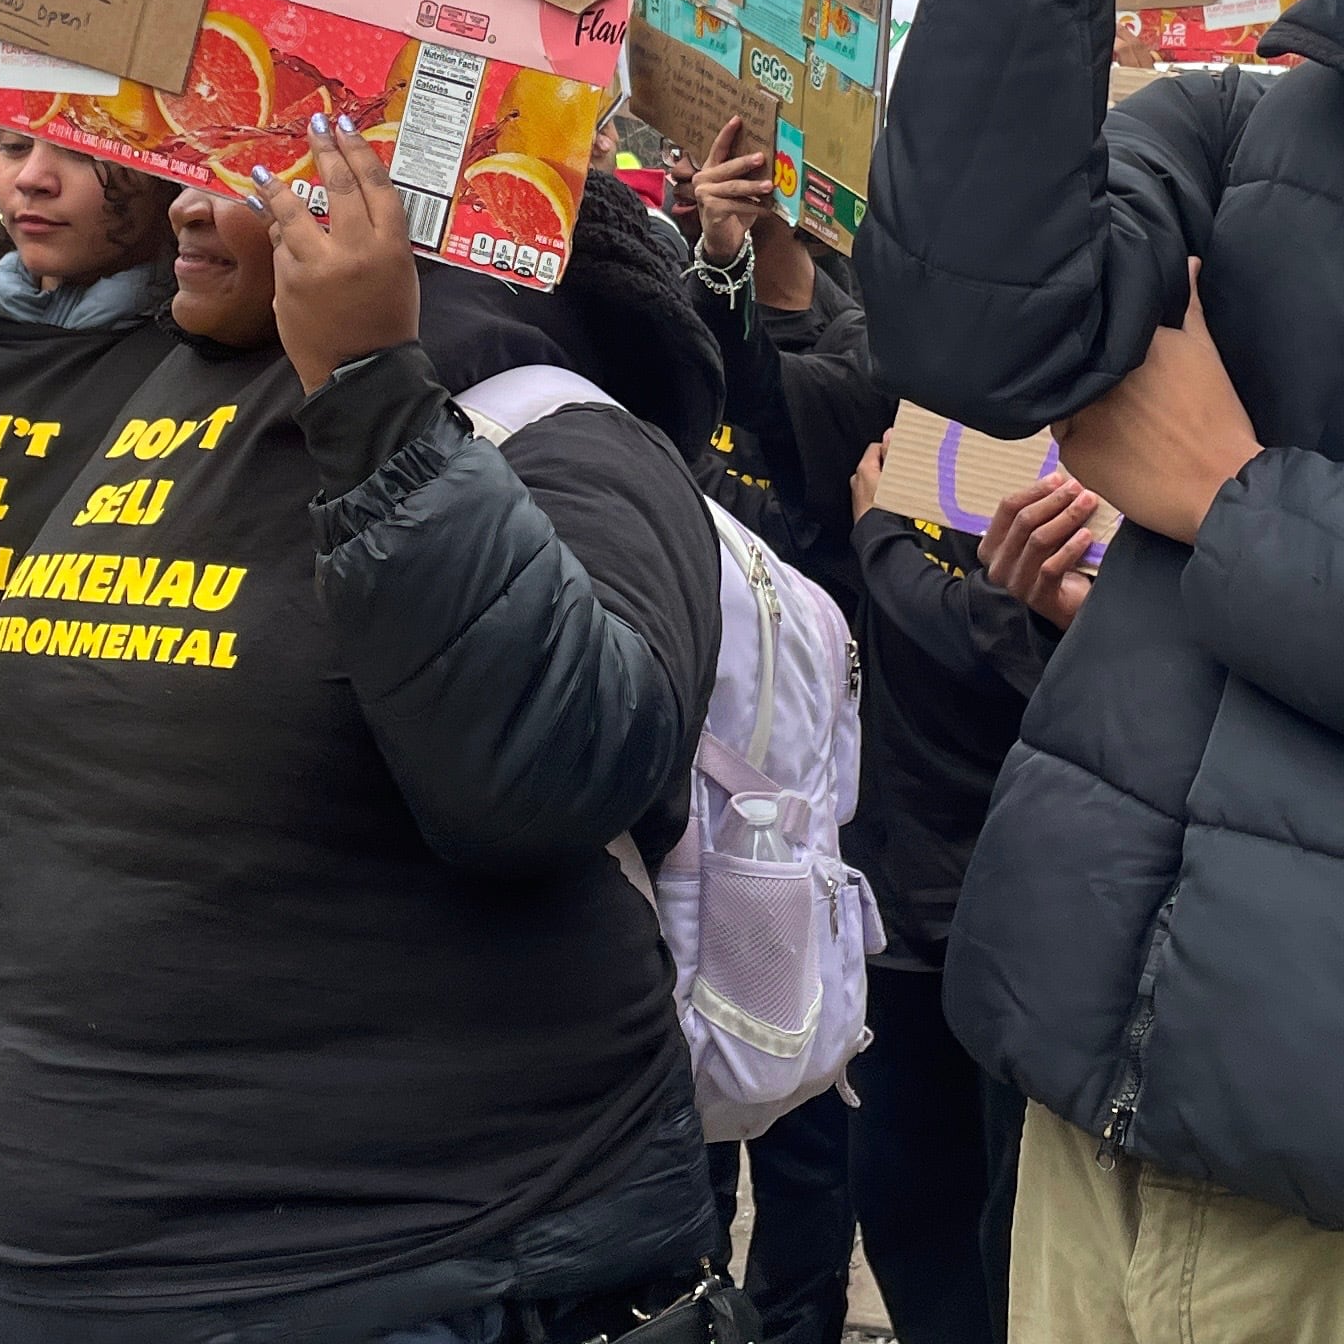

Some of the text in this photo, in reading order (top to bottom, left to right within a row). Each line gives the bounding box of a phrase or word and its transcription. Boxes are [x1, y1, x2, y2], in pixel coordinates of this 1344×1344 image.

[1162, 22, 1187, 36] 12
[1162, 35, 1187, 47] PACK
[415, 77, 474, 102] Calories 0
[72, 478, 175, 527] SELL
[2, 552, 248, 612] ANKENAU
